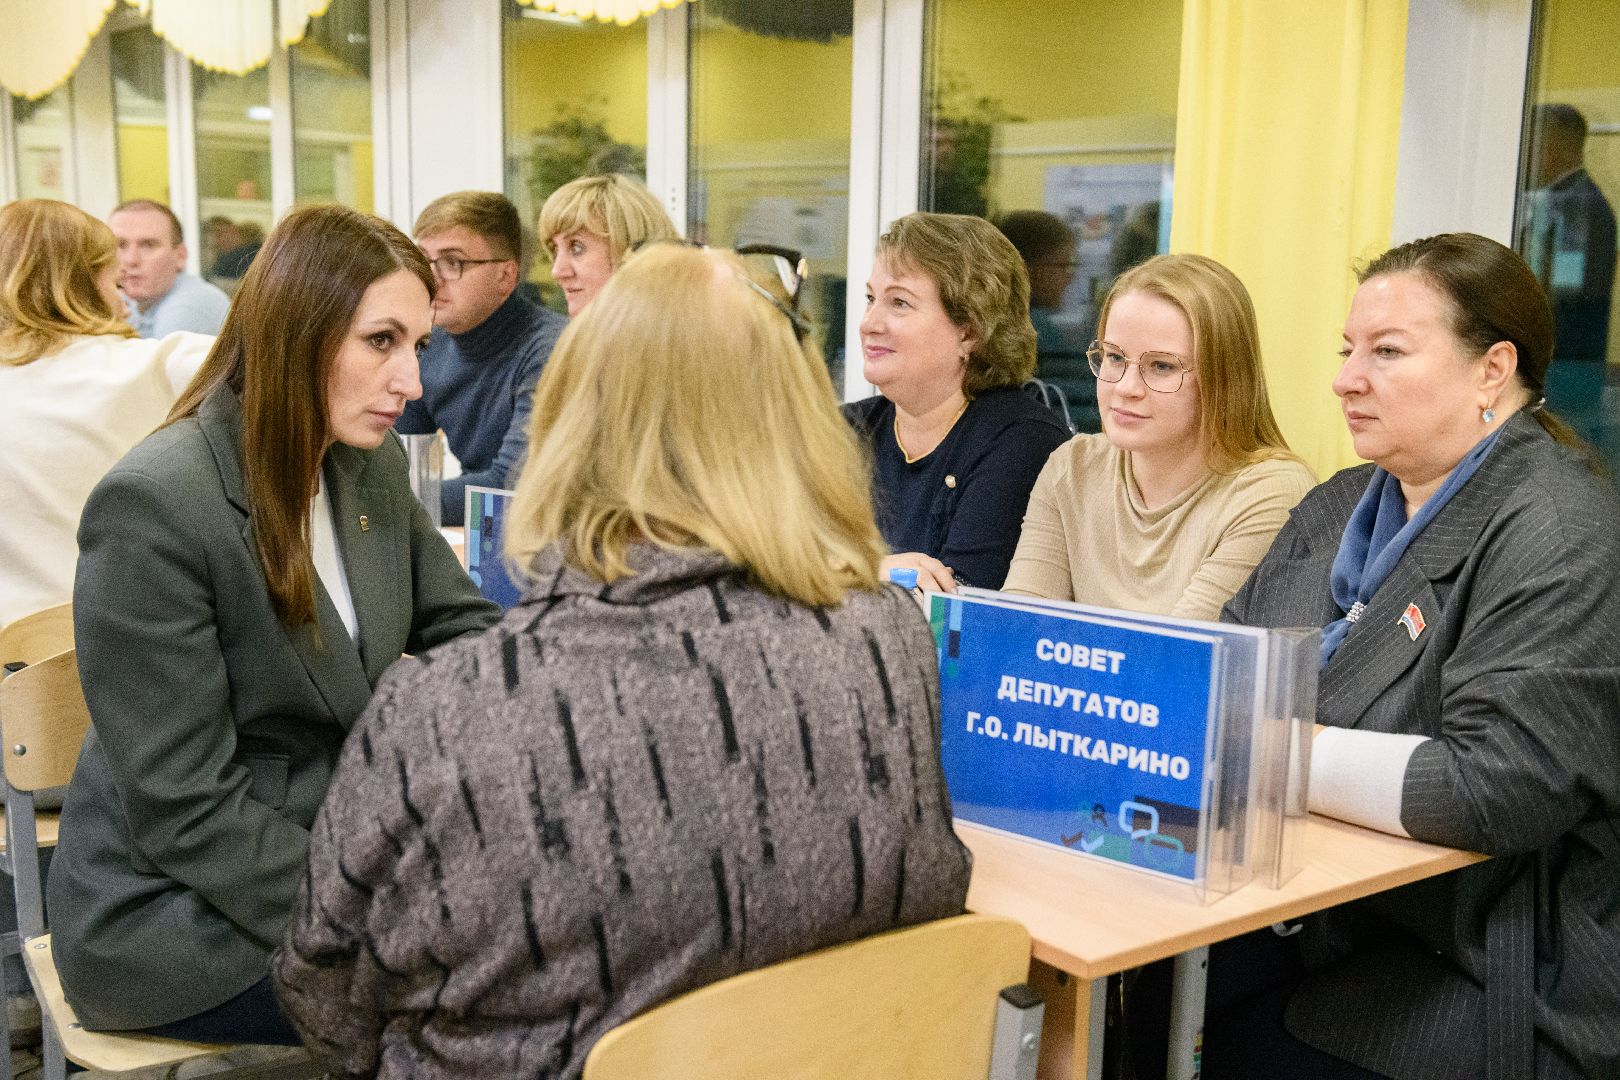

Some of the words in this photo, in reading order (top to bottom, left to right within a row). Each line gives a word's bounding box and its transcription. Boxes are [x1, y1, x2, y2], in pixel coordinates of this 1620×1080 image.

[1035, 638, 1126, 676] СОВЕТ
[997, 674, 1161, 729] ДЕПУТАТОВ
[966, 710, 1009, 741] Г.О.
[1012, 721, 1191, 782] ЛЫТКАРИНО
